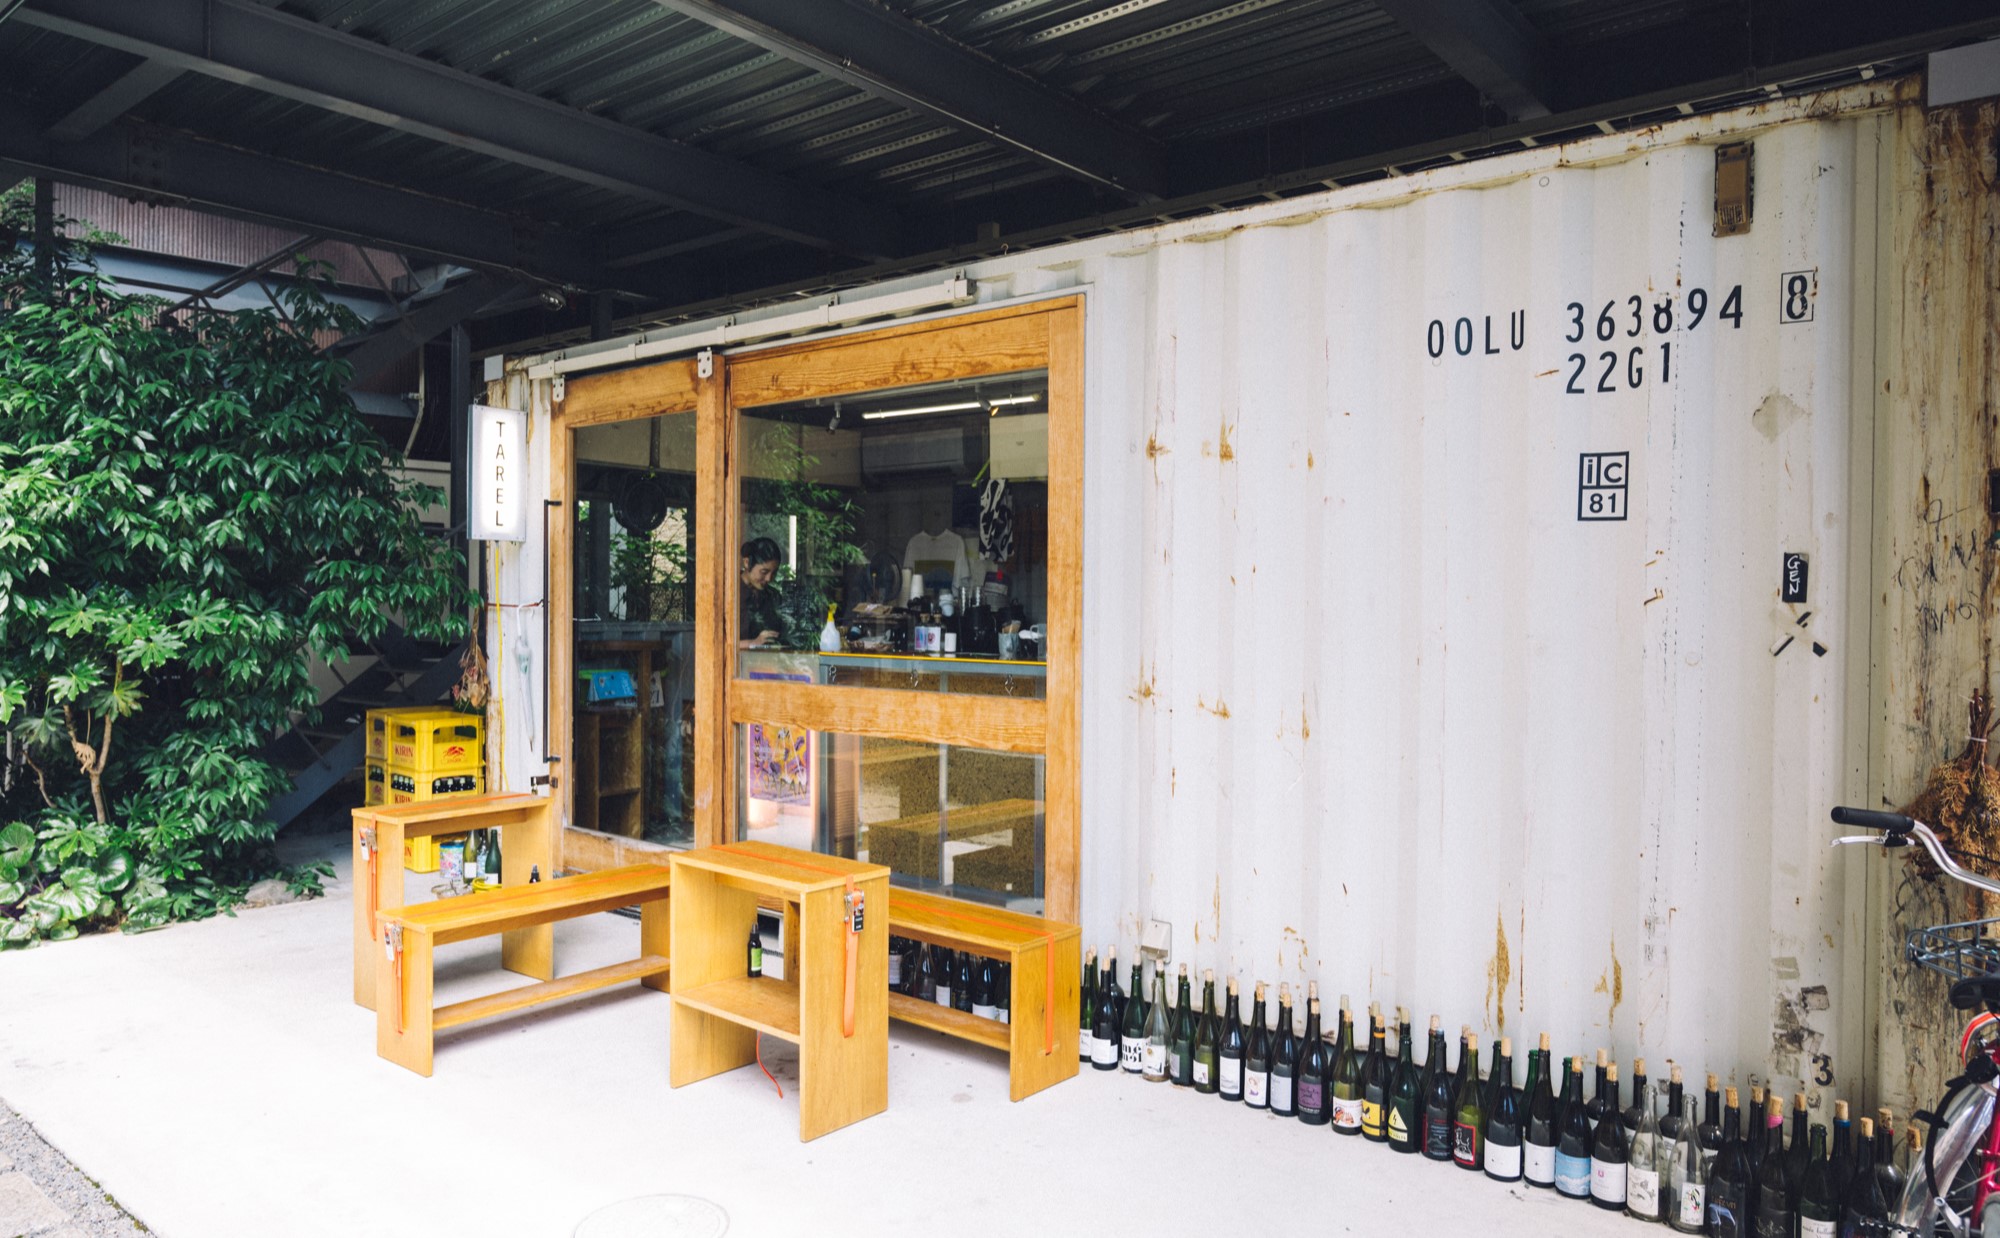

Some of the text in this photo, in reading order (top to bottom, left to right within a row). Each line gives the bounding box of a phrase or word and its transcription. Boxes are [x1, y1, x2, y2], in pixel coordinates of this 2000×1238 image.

[1565, 285, 1744, 343] 363894
[1786, 275, 1808, 320] 8
[1566, 342, 1671, 394] 22G1
[495, 420, 506, 527] TAREL
[1589, 493, 1617, 514] 81
[1786, 555, 1801, 596] GEN
[394, 744, 414, 757] KIRIN
[1812, 1054, 1834, 1087] 3
